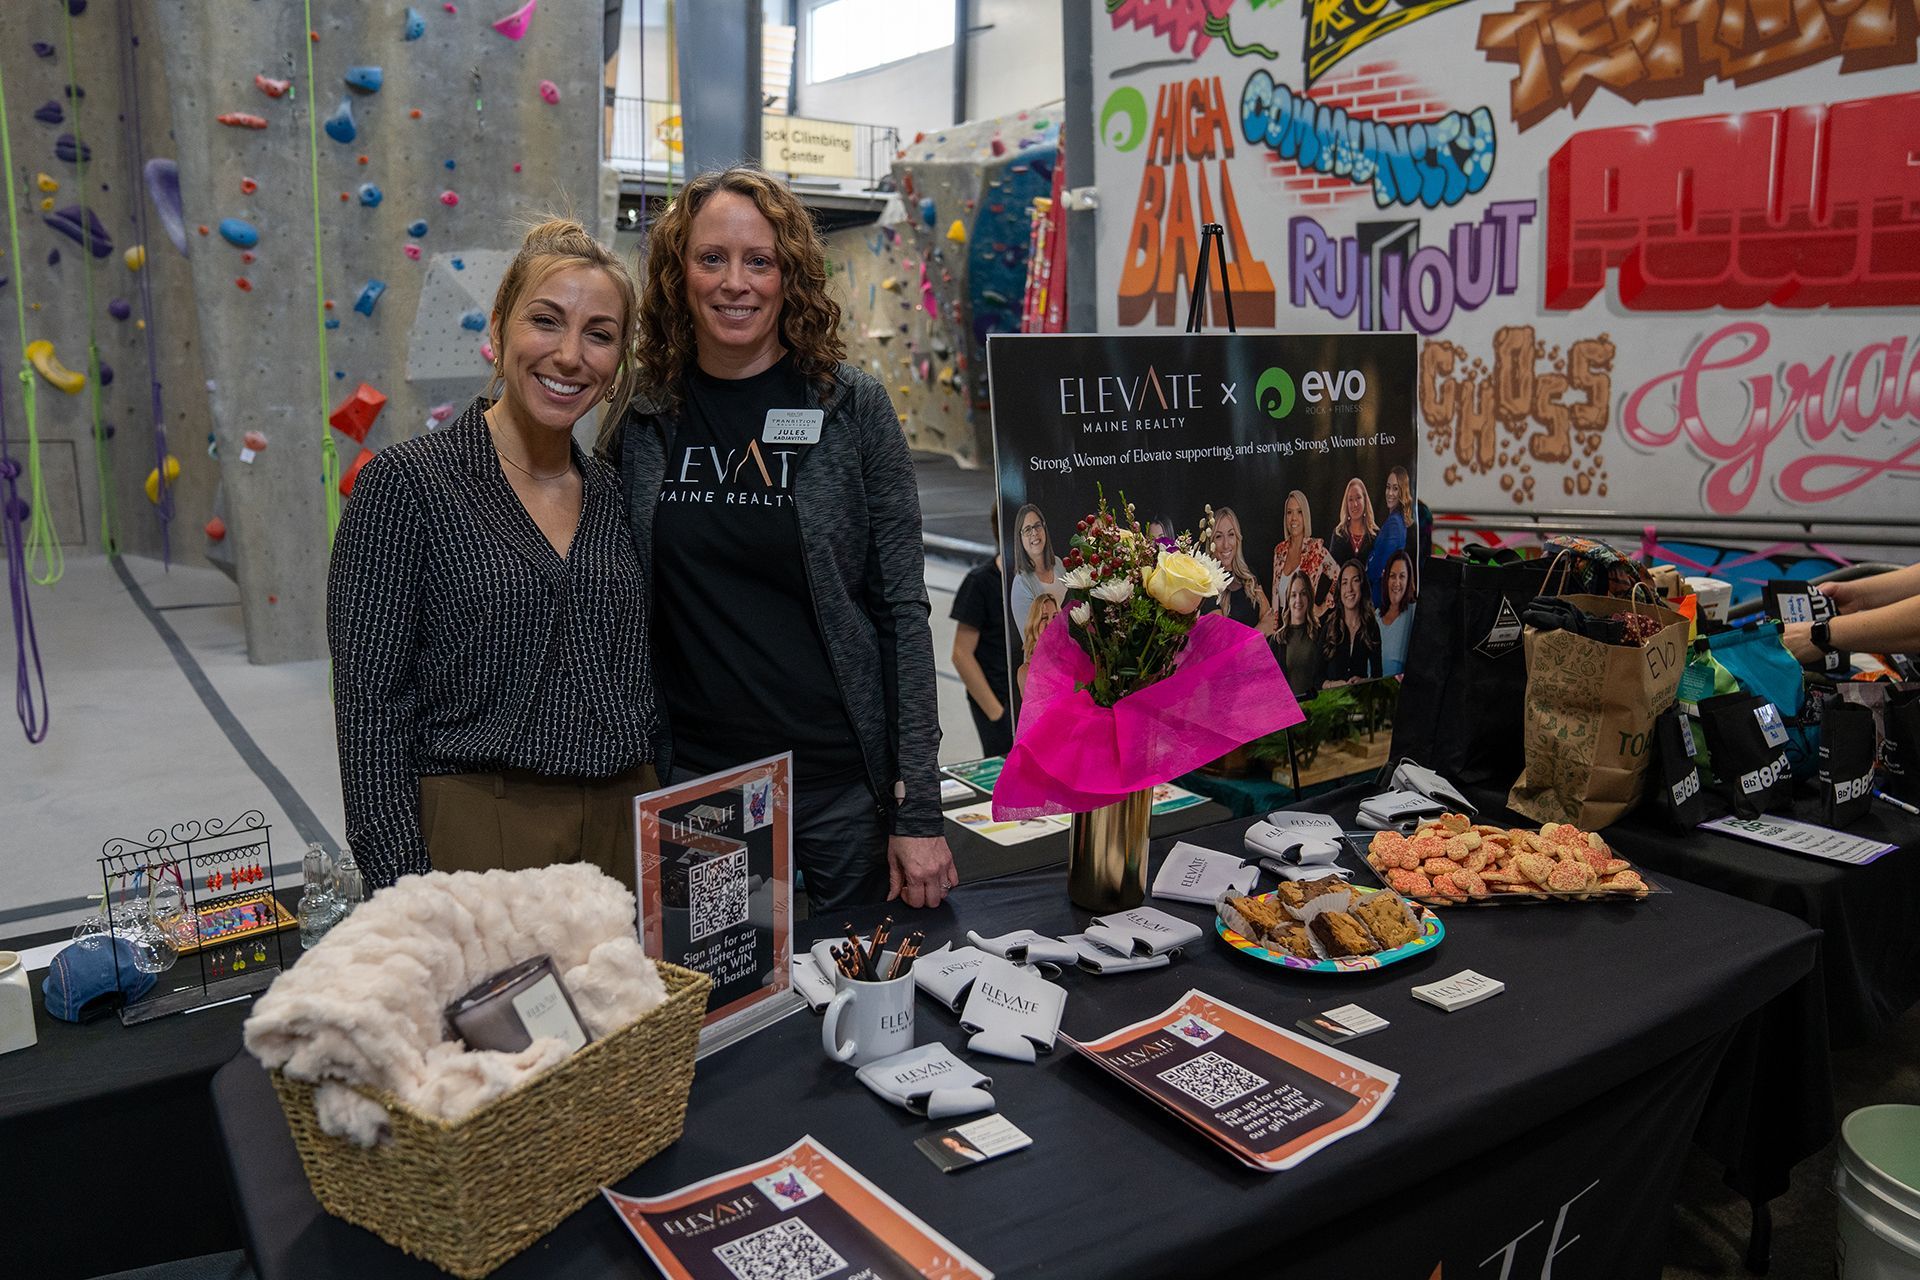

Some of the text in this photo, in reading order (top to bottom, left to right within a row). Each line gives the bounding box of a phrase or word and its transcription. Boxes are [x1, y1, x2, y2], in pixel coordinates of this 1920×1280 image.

[1148, 77, 1234, 165] HIGH
[1240, 68, 1496, 209] COMMUNITY
[780, 148, 825, 164] Center
[791, 129, 850, 151] Climbing
[1288, 201, 1537, 335] RUNOUT
[1060, 365, 1203, 415] ELEVATE
[1302, 369, 1366, 403] evo
[1420, 325, 1615, 475] CHOSS
[1083, 417, 1186, 434] MAINE REALTY
[1334, 403, 1364, 414] FITNESS
[1624, 322, 1920, 513] Gra
[664, 439, 797, 489] EVAT
[1030, 433, 1396, 474] Strong Women of Elevate supporting and serving Strong Women of Evo
[683, 928, 757, 966] Sign up for our
[738, 936, 757, 954] and
[717, 966, 728, 976] to
[730, 951, 752, 969] WIN
[723, 960, 757, 985] basket!
[982, 982, 1040, 1014] ELEVATE
[881, 1010, 911, 1030] ELEV
[895, 1060, 956, 1084] ELEVATE
[1214, 1083, 1292, 1121] Sign up for our
[1225, 1087, 1303, 1128] Newsletter and
[1243, 1096, 1309, 1132] enter to WIN
[1249, 1127, 1268, 1140] our
[1268, 1118, 1289, 1132] gift
